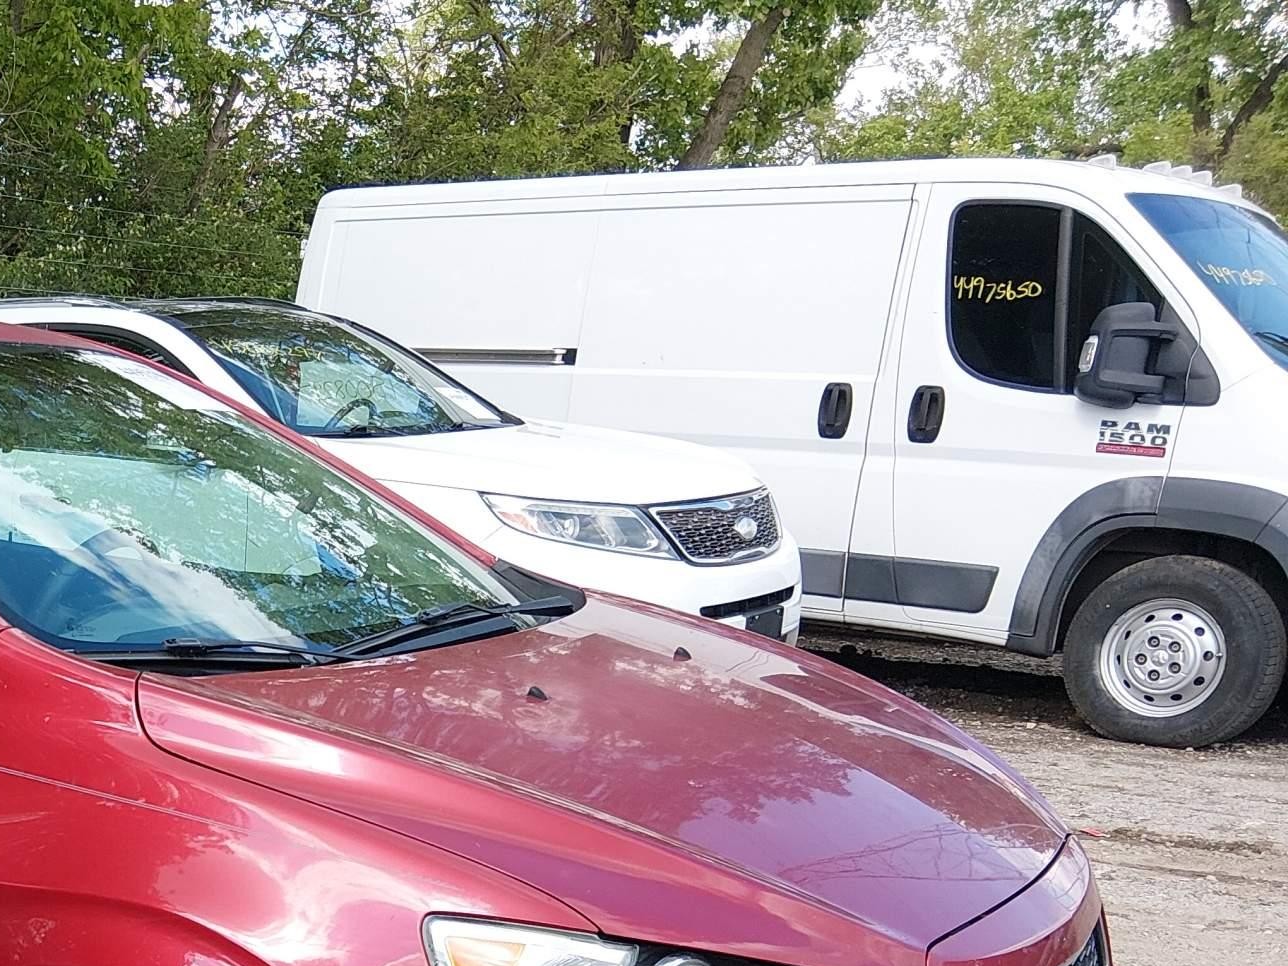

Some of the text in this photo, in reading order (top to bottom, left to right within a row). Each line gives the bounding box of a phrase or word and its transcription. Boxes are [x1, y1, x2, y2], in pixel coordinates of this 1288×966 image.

[953, 274, 1043, 304] 44975650
[1098, 419, 1172, 436] RAM
[1097, 431, 1169, 447] 1500
